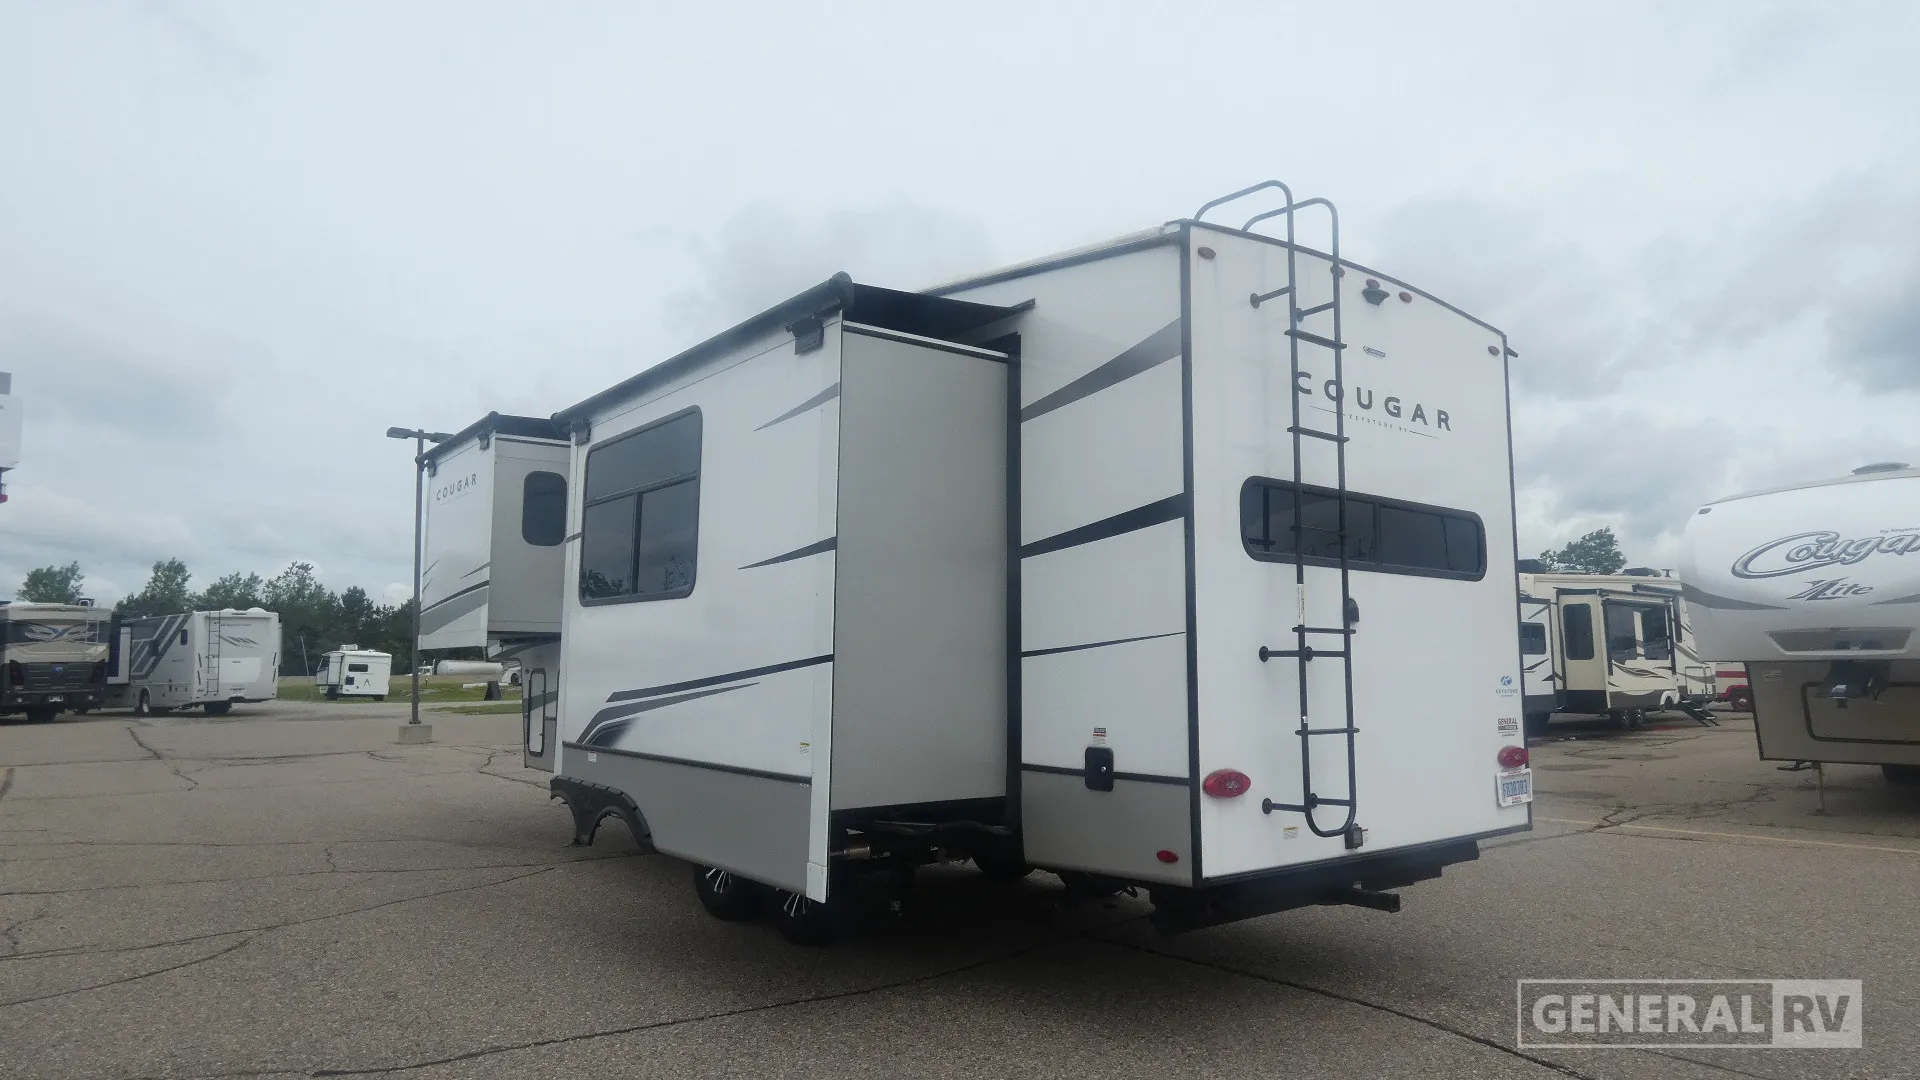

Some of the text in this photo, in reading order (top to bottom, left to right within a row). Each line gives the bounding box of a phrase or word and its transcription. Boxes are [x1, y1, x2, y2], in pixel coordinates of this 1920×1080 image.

[1296, 371, 1451, 431] COUGAR
[436, 473, 477, 501] COUGAR
[1786, 577, 1873, 601] Lite
[1498, 718, 1518, 726] GENERAL
